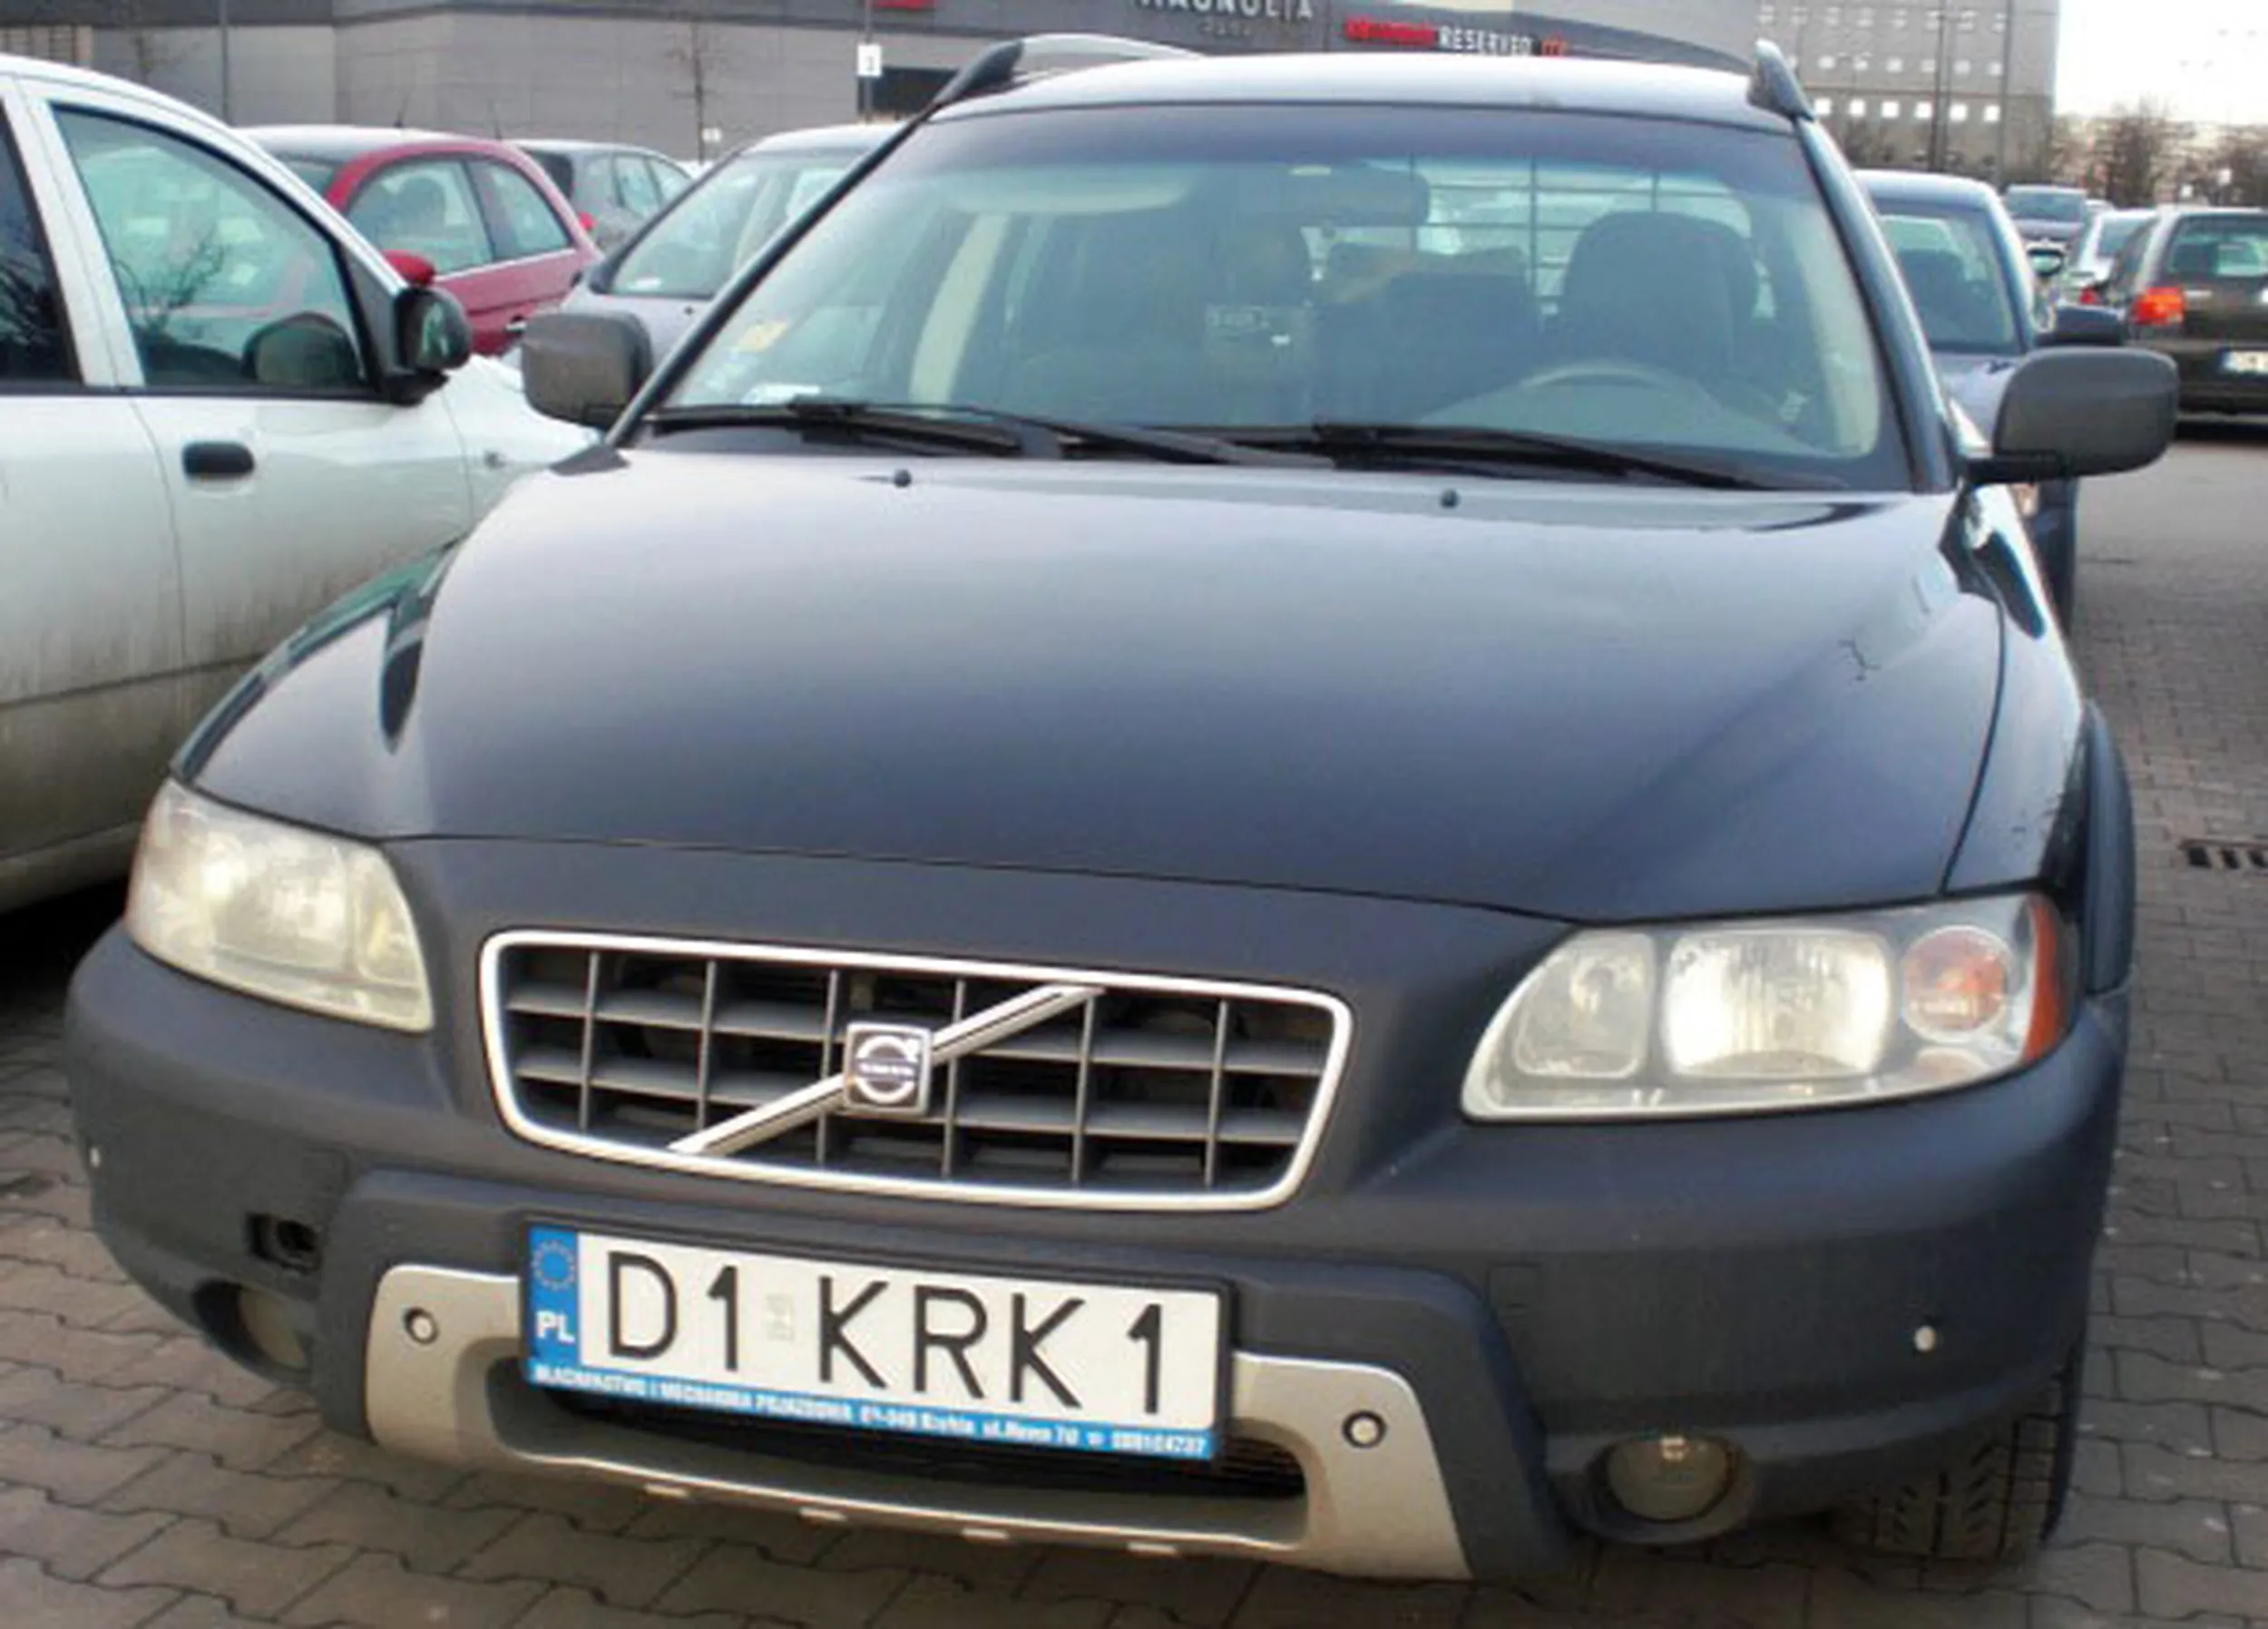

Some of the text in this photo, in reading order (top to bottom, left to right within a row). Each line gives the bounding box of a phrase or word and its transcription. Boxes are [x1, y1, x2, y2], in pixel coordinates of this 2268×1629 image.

[1135, 0, 1314, 20] GNOLIA
[1438, 25, 1533, 55] RESERVED
[536, 1309, 576, 1344] PL
[607, 1250, 738, 1372] D1
